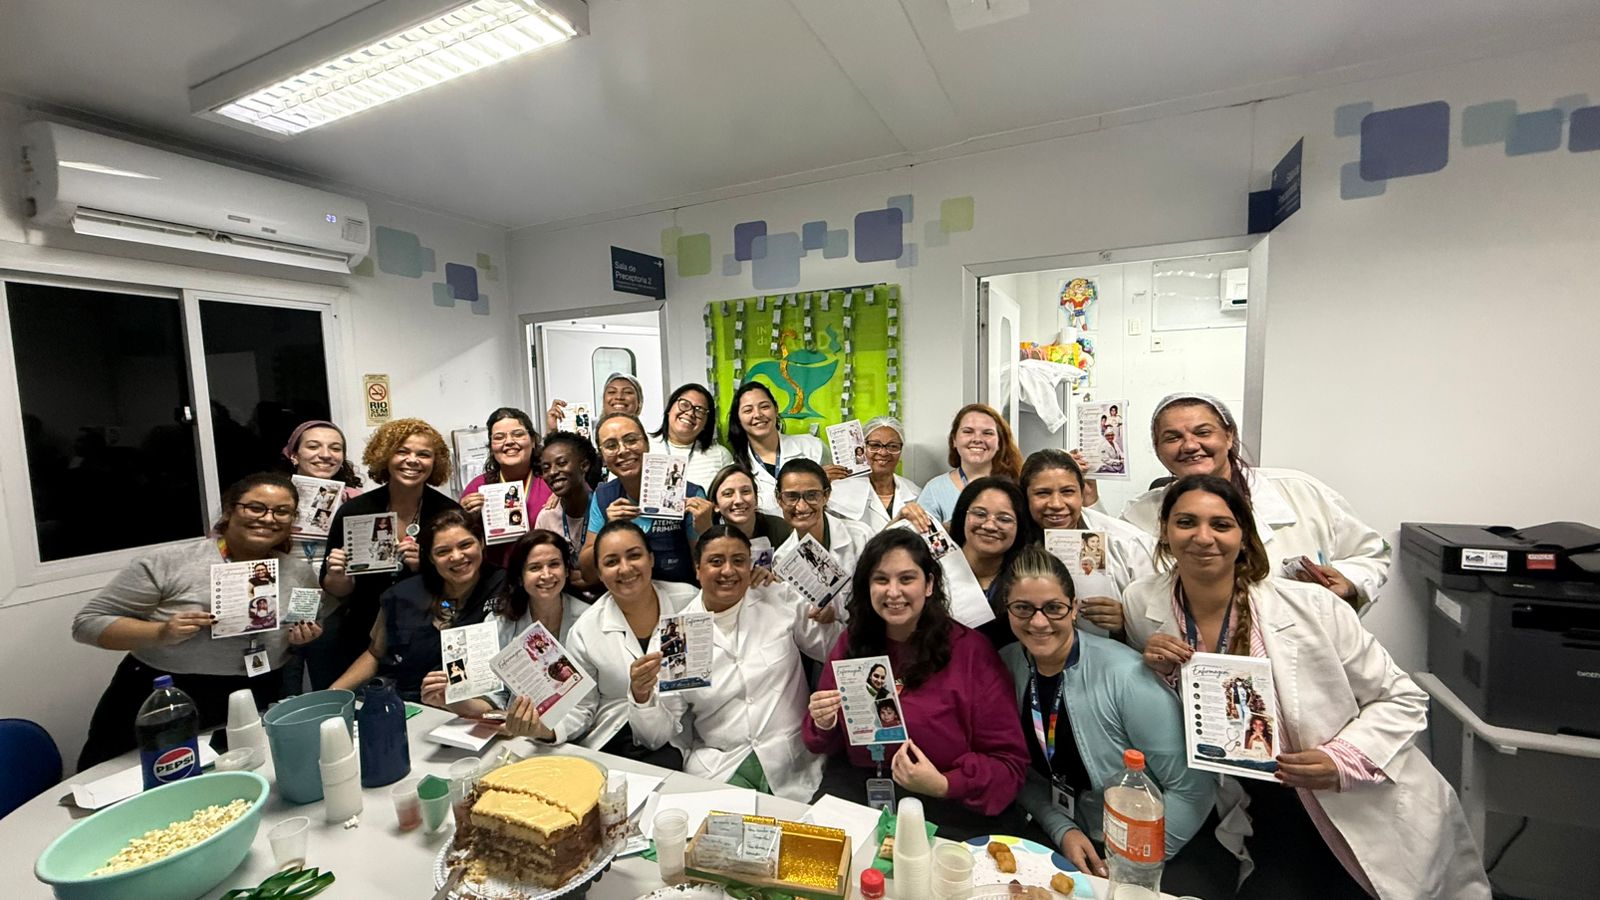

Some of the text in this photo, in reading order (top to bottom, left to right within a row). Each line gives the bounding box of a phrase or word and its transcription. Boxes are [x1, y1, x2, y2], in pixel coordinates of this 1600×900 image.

[325, 213, 337, 223] 23
[614, 260, 628, 271] Sala
[369, 401, 388, 409] RIO
[156, 756, 194, 773] PEPSI
